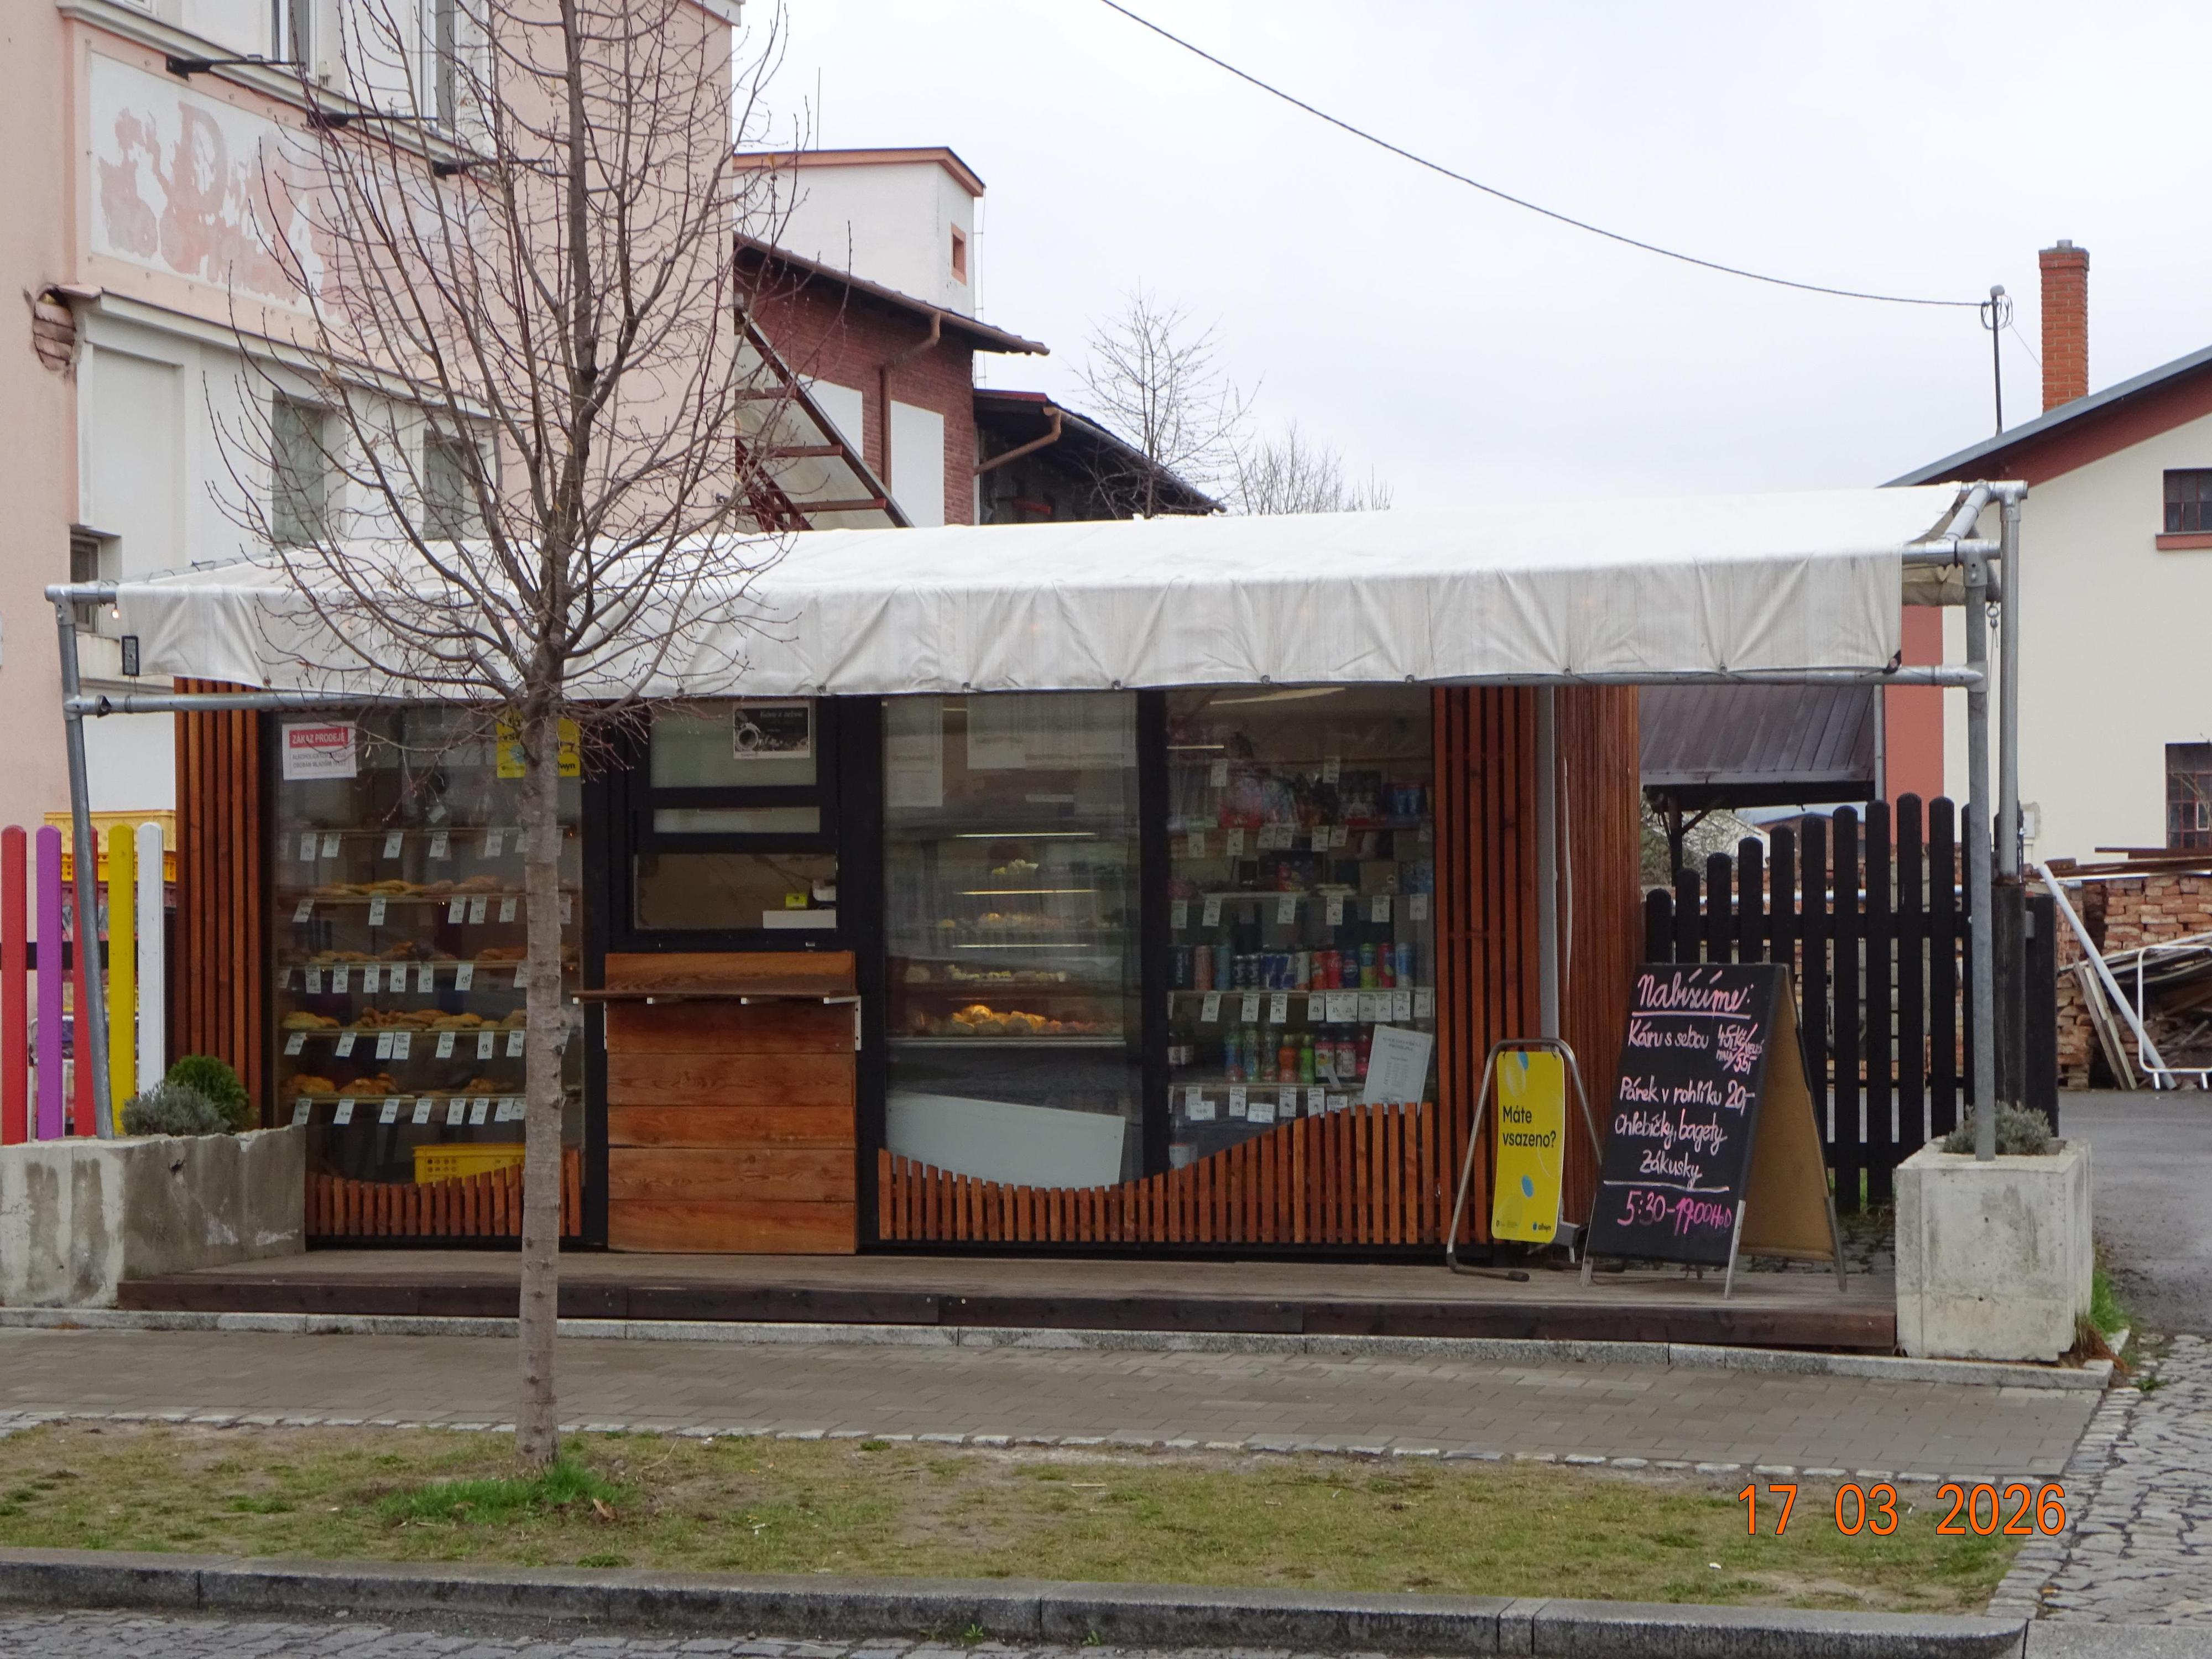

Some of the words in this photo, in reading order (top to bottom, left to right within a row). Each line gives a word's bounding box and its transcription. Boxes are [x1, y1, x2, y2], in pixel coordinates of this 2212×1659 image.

[1664, 1031, 1673, 1047] s
[1674, 1024, 1709, 1050] sebou
[1619, 1074, 1658, 1103] Párek
[1661, 1088, 1669, 1103] v
[1673, 1078, 1722, 1107] rohlíku
[1503, 1105, 1532, 1124] Máte
[1503, 1130, 1556, 1149] vsazeno?
[1678, 1108, 1728, 1157] bagety
[1640, 1149, 1703, 1189] Zákusky
